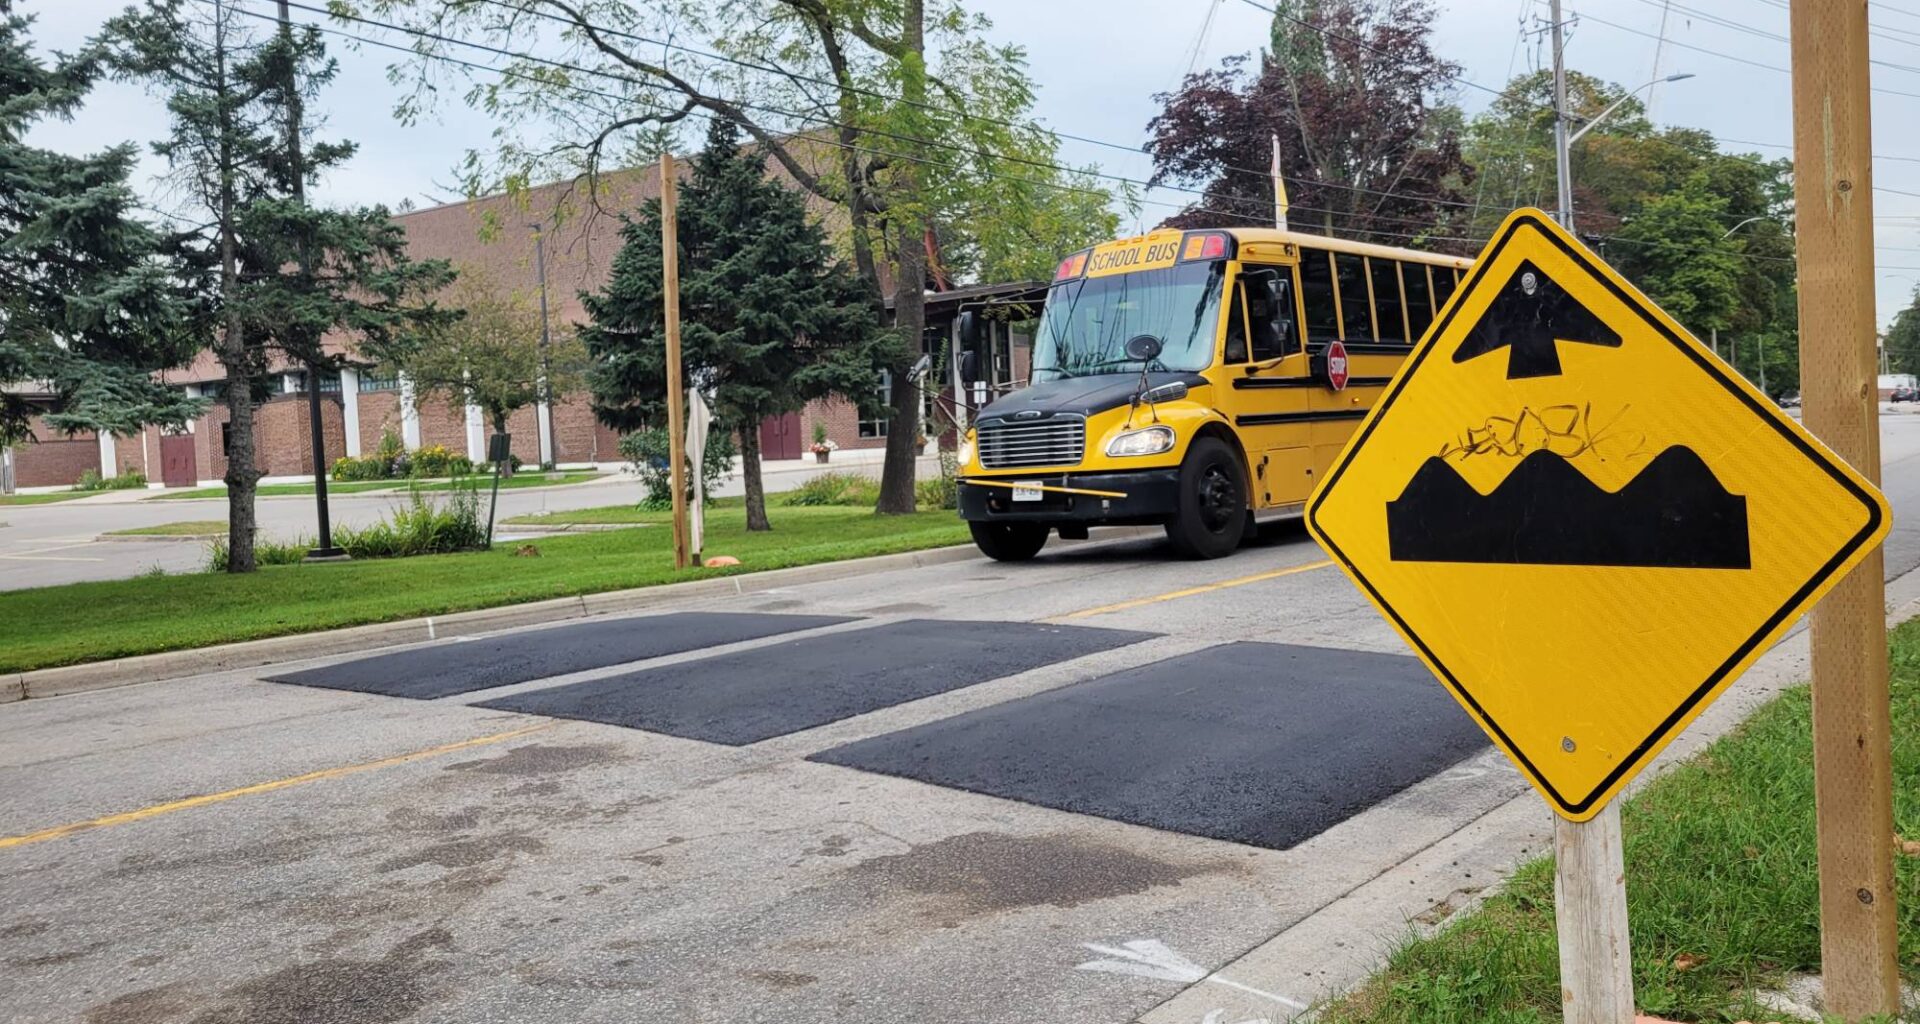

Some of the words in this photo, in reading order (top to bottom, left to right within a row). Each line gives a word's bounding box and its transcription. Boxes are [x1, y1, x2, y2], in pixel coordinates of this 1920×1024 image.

[1090, 247, 1142, 271] SCHOOL
[1145, 242, 1178, 263] BUS
[1331, 357, 1345, 374] STOP
